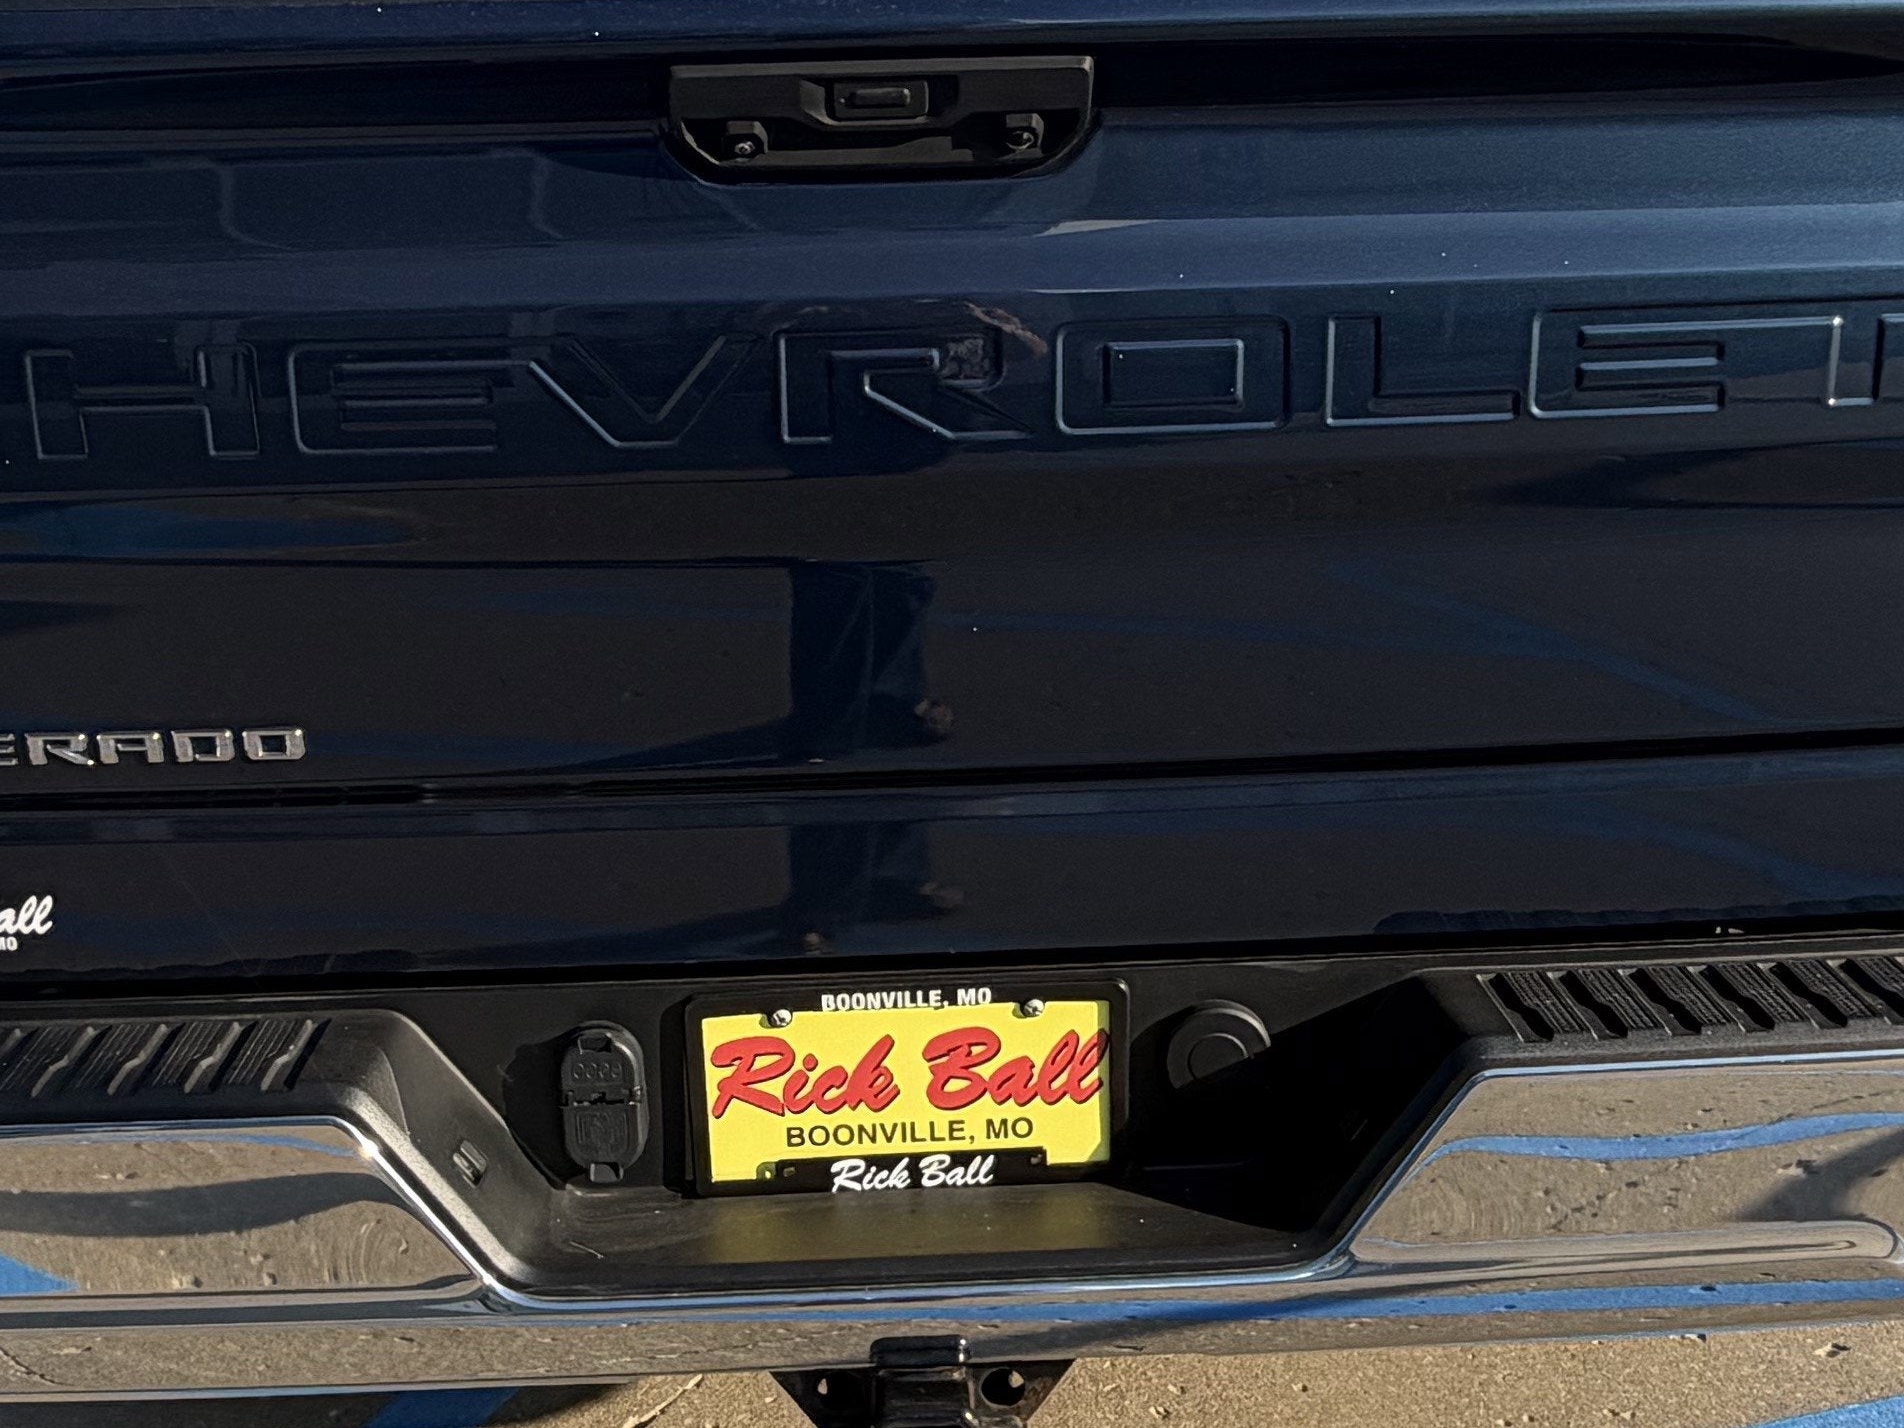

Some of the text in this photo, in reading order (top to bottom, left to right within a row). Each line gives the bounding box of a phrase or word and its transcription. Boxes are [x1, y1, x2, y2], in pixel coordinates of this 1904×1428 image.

[821, 987, 993, 1012] BOONVILLE, MO
[711, 1026, 1110, 1119] Rick Ball
[786, 1117, 1034, 1148] BOONVILLE, MO
[830, 1154, 996, 1193] Rick Ball
